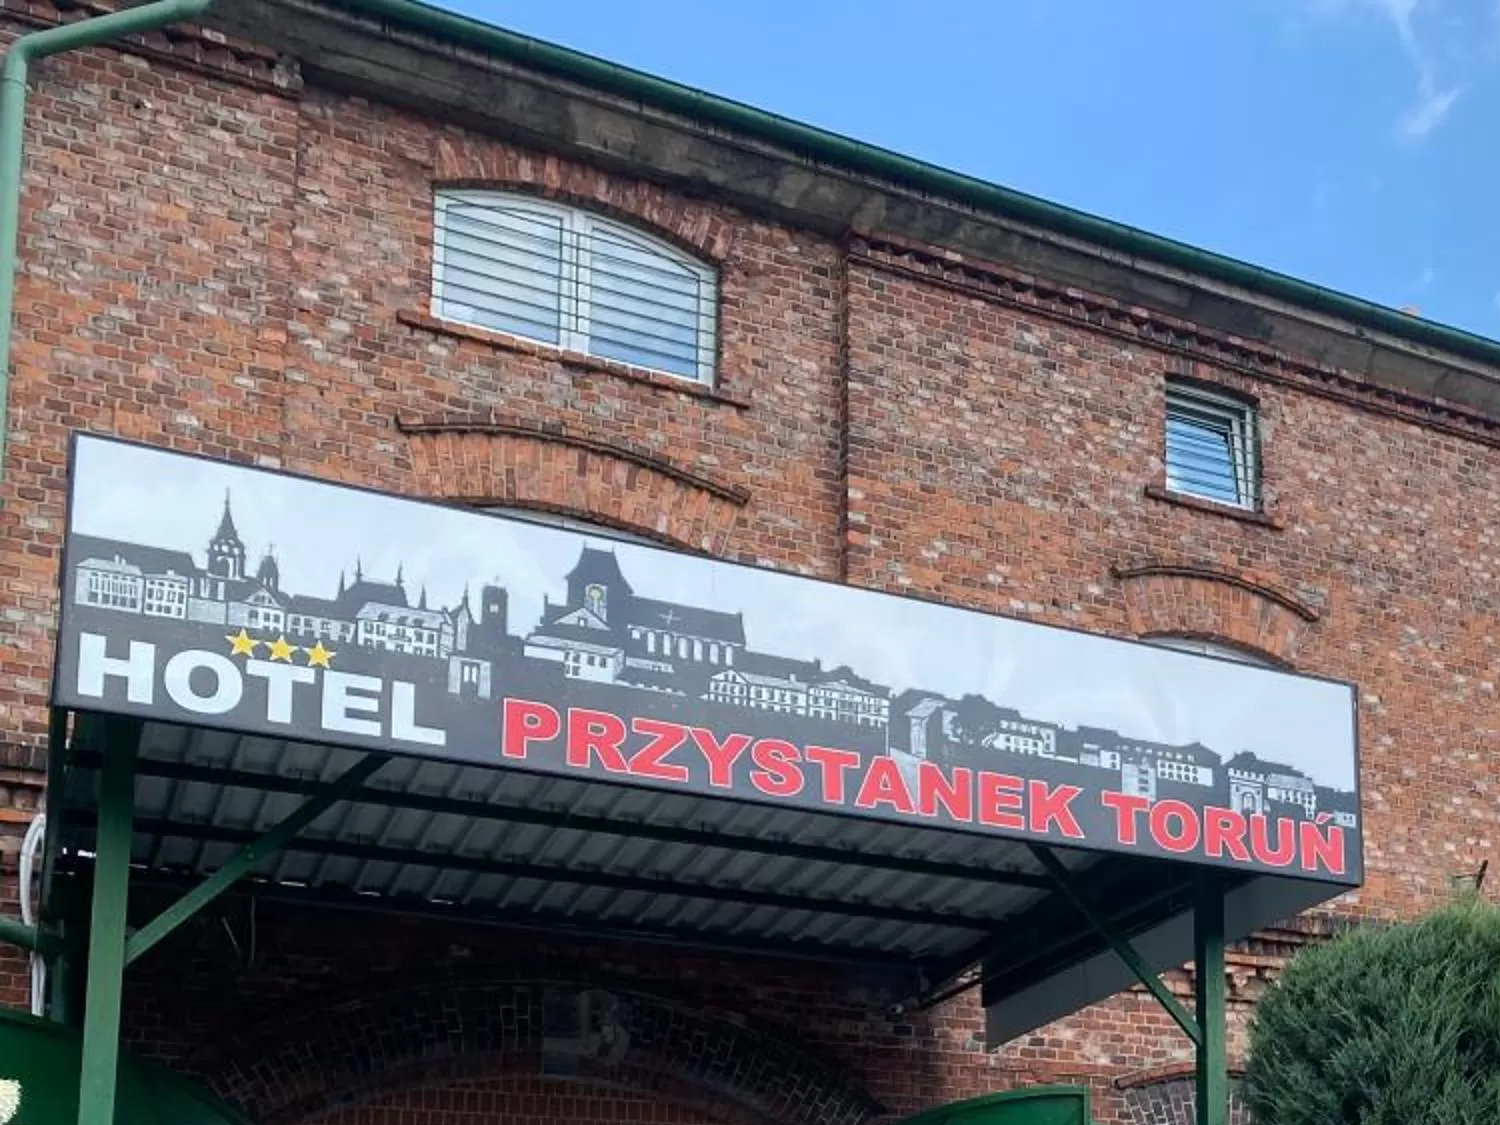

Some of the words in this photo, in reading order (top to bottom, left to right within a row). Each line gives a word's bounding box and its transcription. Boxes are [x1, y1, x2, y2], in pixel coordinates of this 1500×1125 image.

[77, 632, 446, 745] HOTEL
[503, 697, 1085, 839] PRZYSTANEK
[1101, 790, 1345, 875] TORUŃ
